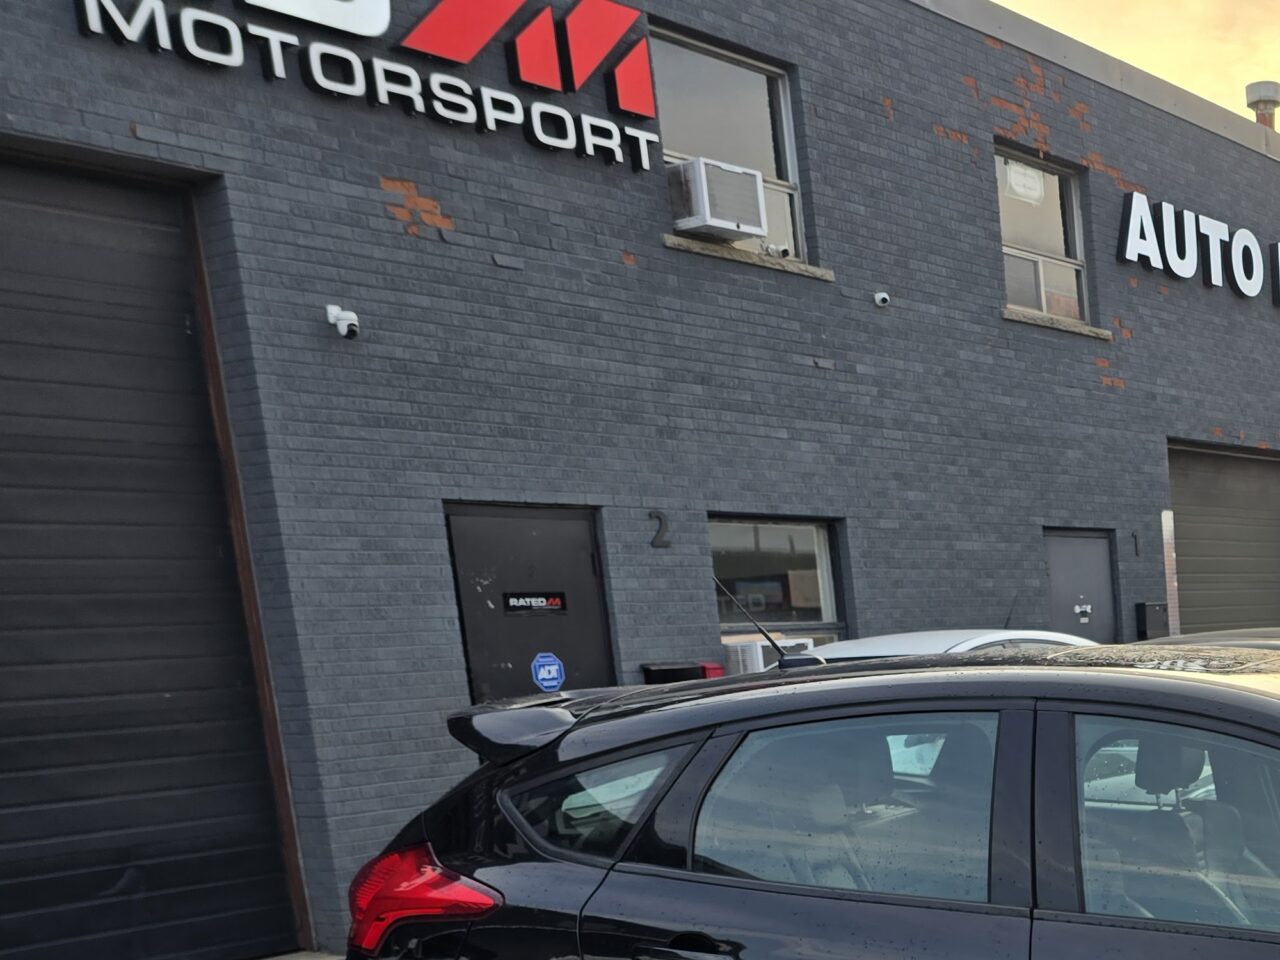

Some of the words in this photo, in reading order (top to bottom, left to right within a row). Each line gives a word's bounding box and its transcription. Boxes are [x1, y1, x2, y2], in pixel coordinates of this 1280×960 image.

[84, 0, 660, 171] MOTORSPORT
[1124, 190, 1265, 298] AUTO
[648, 510, 673, 549] 2
[537, 663, 560, 680] ADT
